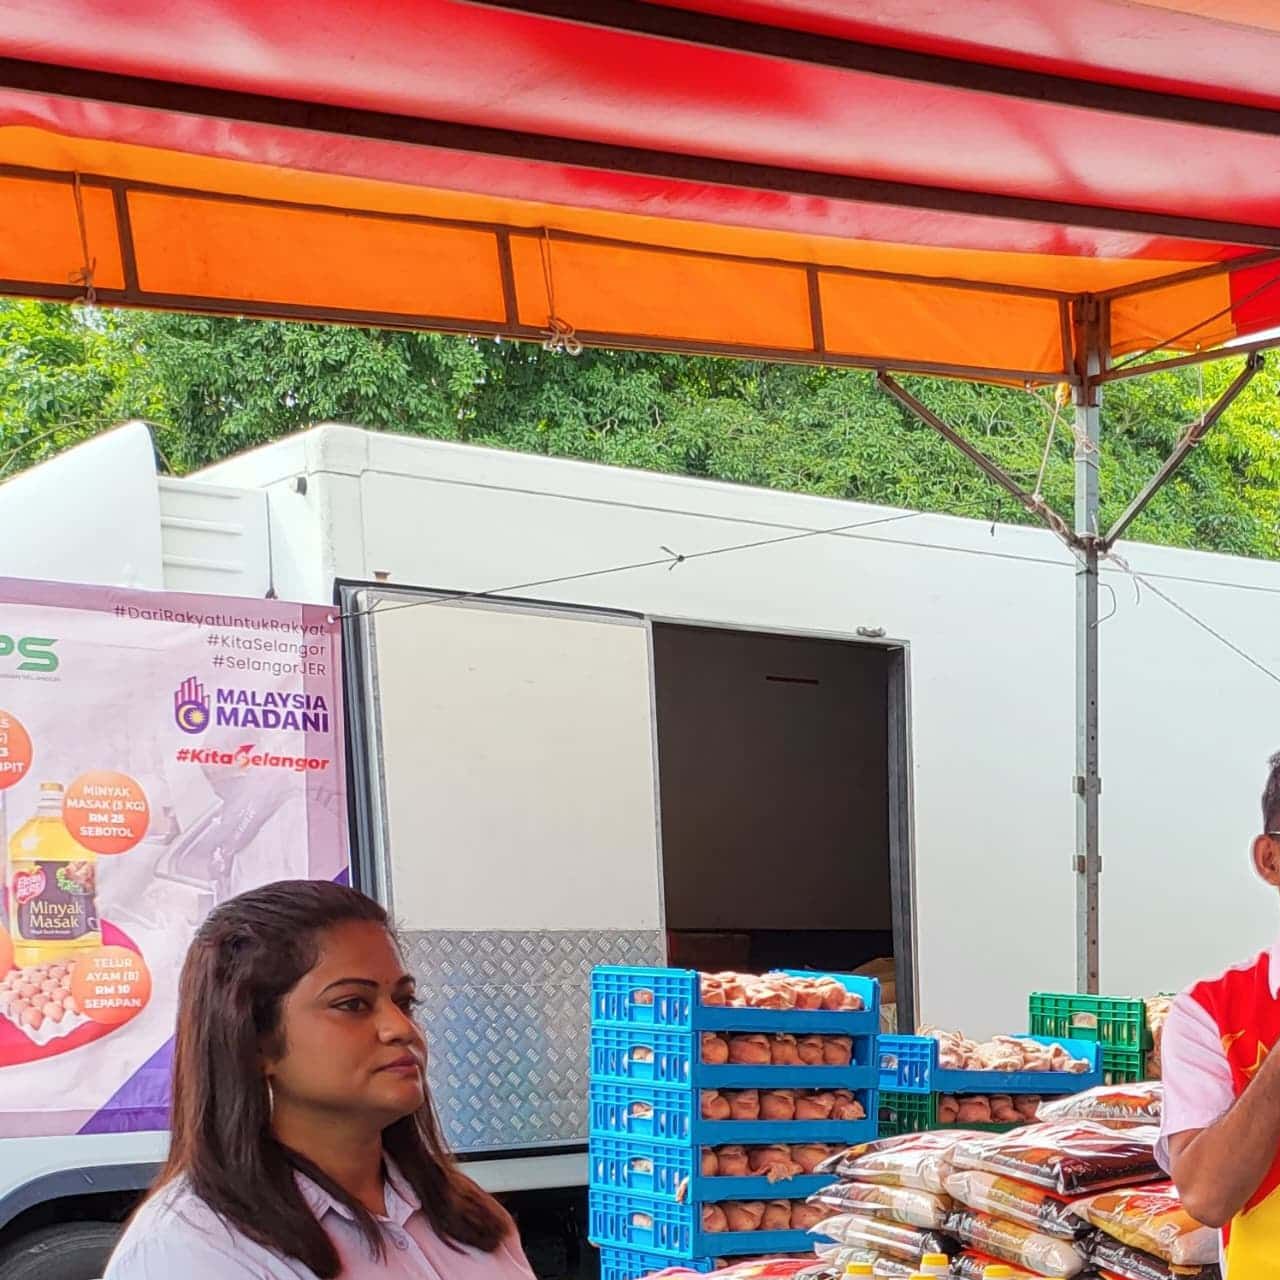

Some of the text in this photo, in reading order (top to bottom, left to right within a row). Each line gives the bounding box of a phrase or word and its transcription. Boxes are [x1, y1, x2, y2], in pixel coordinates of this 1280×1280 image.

[114, 605, 326, 637] #DariRakyatUntukRakyat
[207, 634, 326, 658] #KitaSelangor
[212, 654, 326, 676] #SelangorJER
[216, 688, 328, 711] MALAYSIA
[216, 707, 329, 733] MADANI
[80, 825, 134, 838] SEBOTOL
[30, 900, 84, 918] Minyak
[30, 914, 80, 929] Masak
[85, 998, 141, 1009] SEPAPAN
